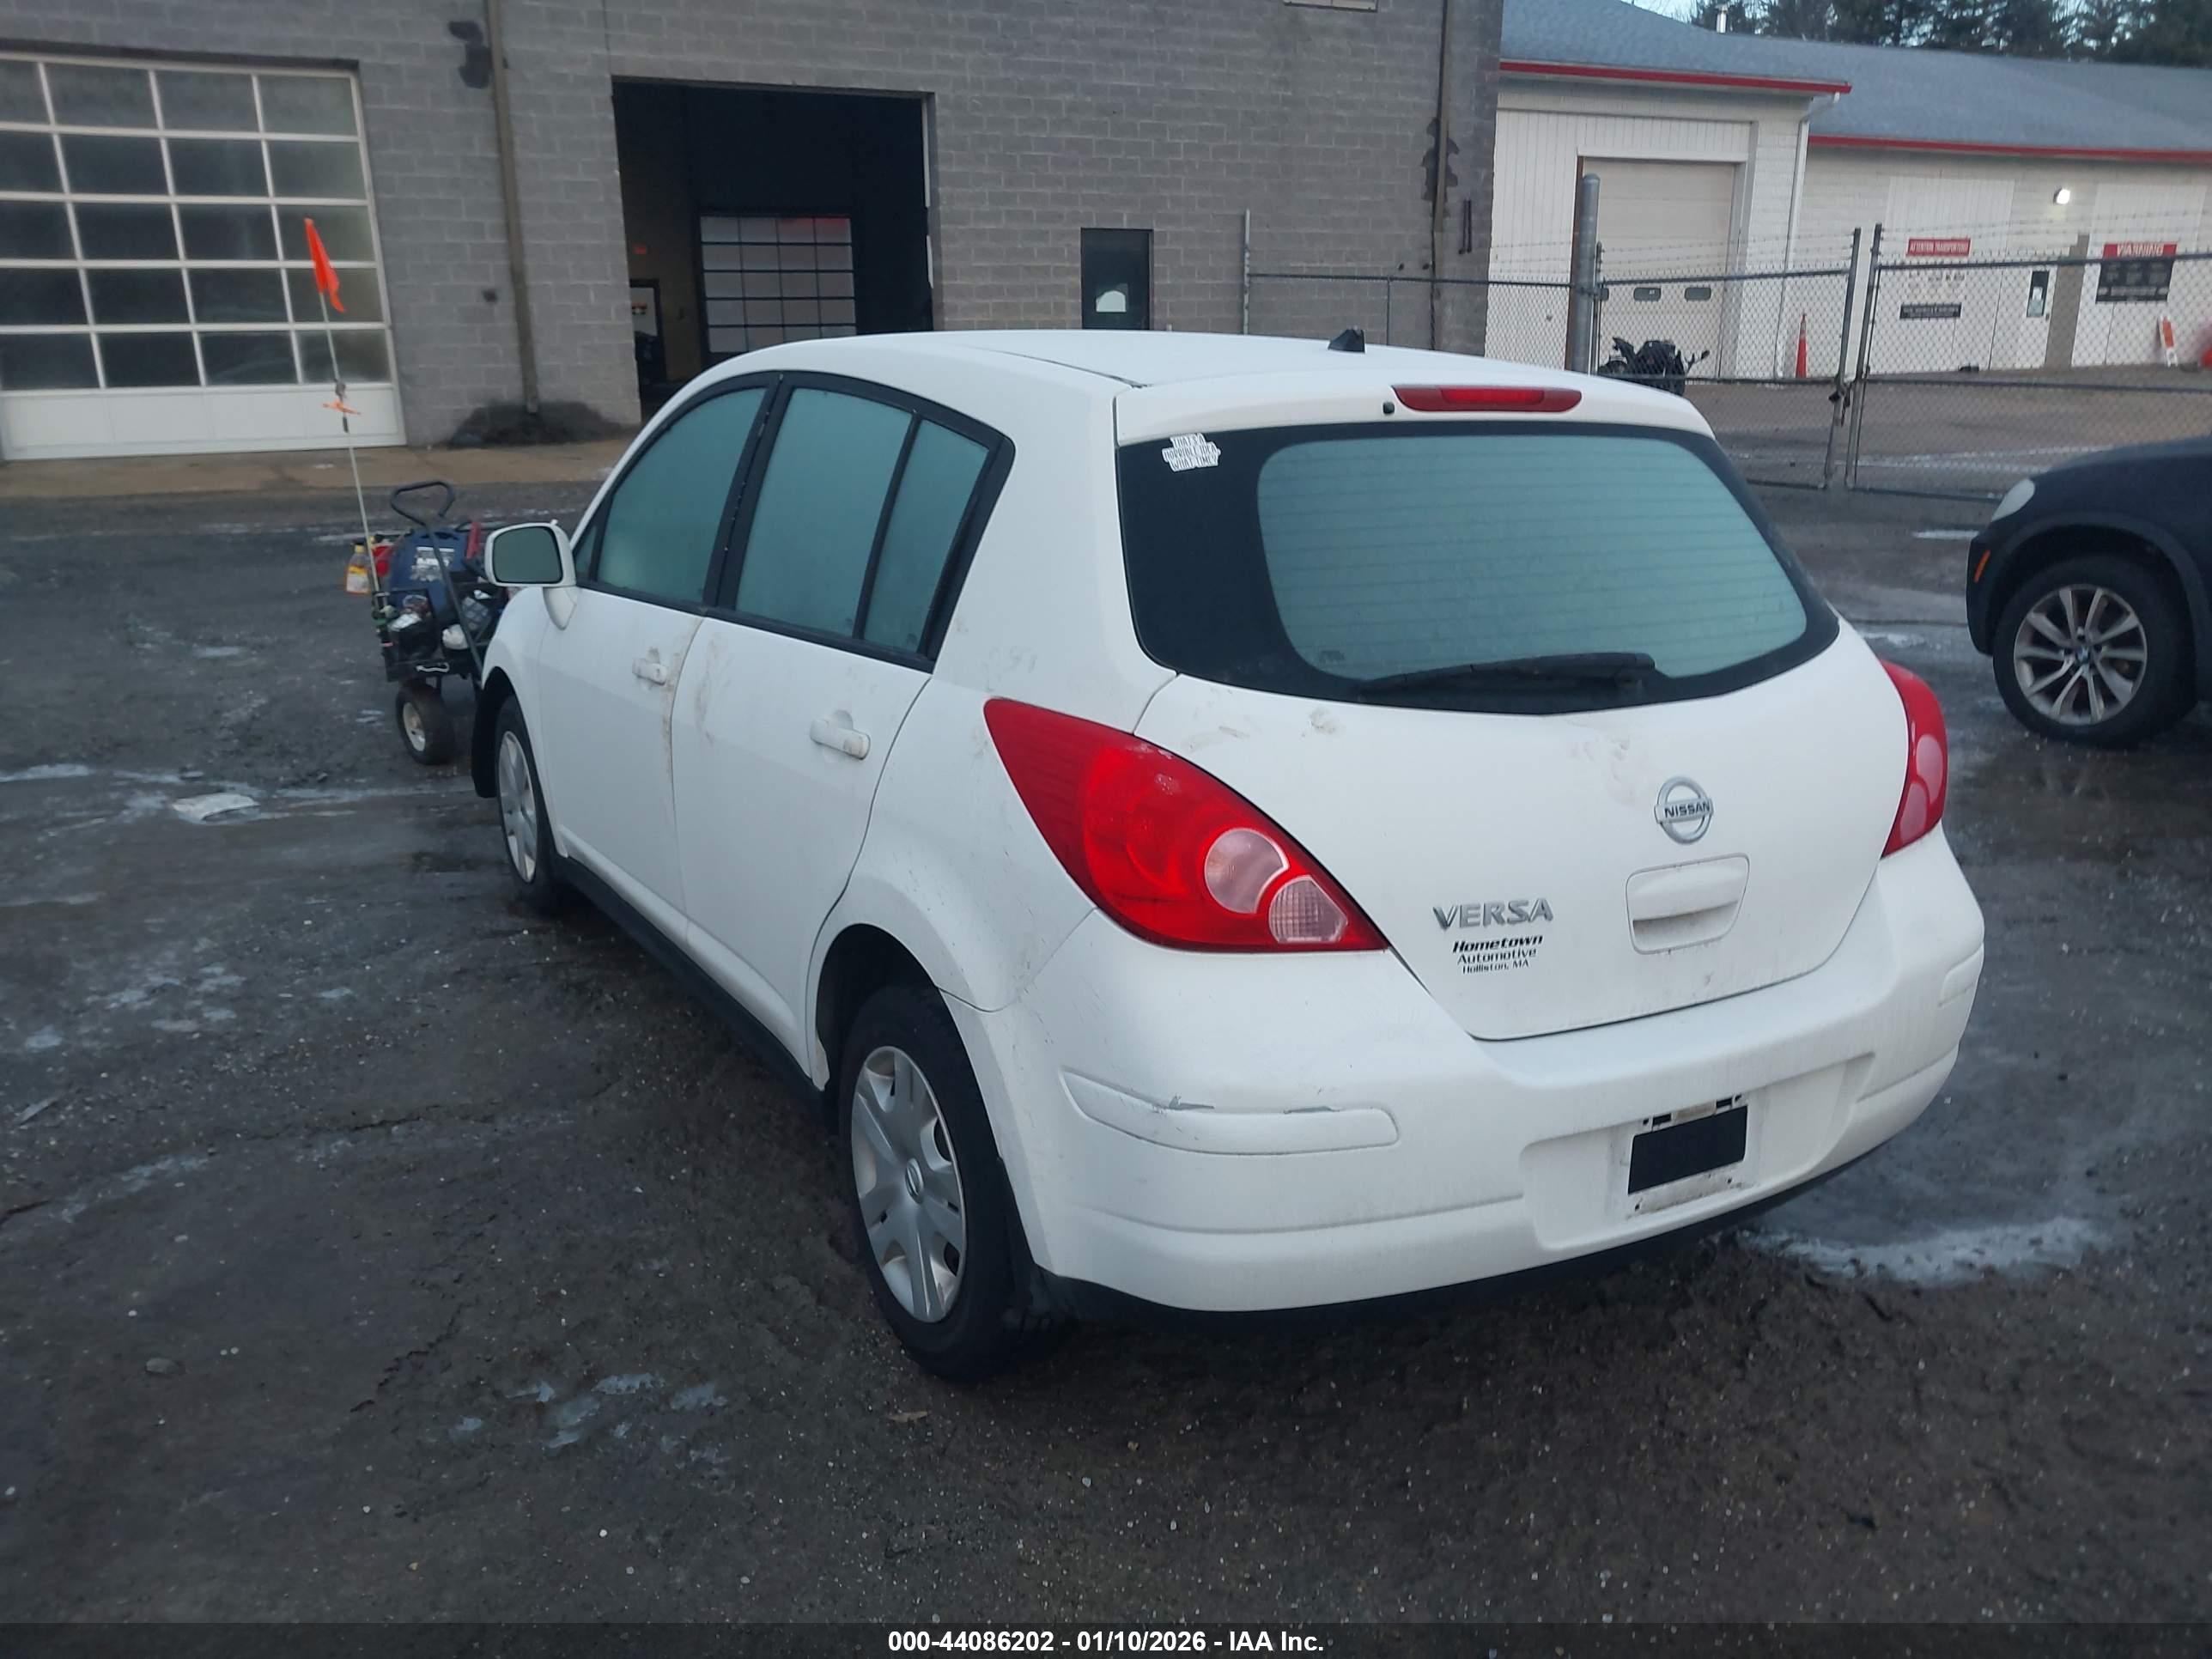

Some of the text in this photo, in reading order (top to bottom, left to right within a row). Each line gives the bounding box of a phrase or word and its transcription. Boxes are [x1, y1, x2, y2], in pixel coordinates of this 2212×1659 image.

[2117, 243, 2164, 258] WARNING
[1664, 800, 1711, 818] NISSAN
[1432, 898, 1553, 931] VERSA
[1452, 935, 1543, 953] Hometown
[1456, 948, 1537, 965] Automotive
[1512, 958, 1530, 969] MA
